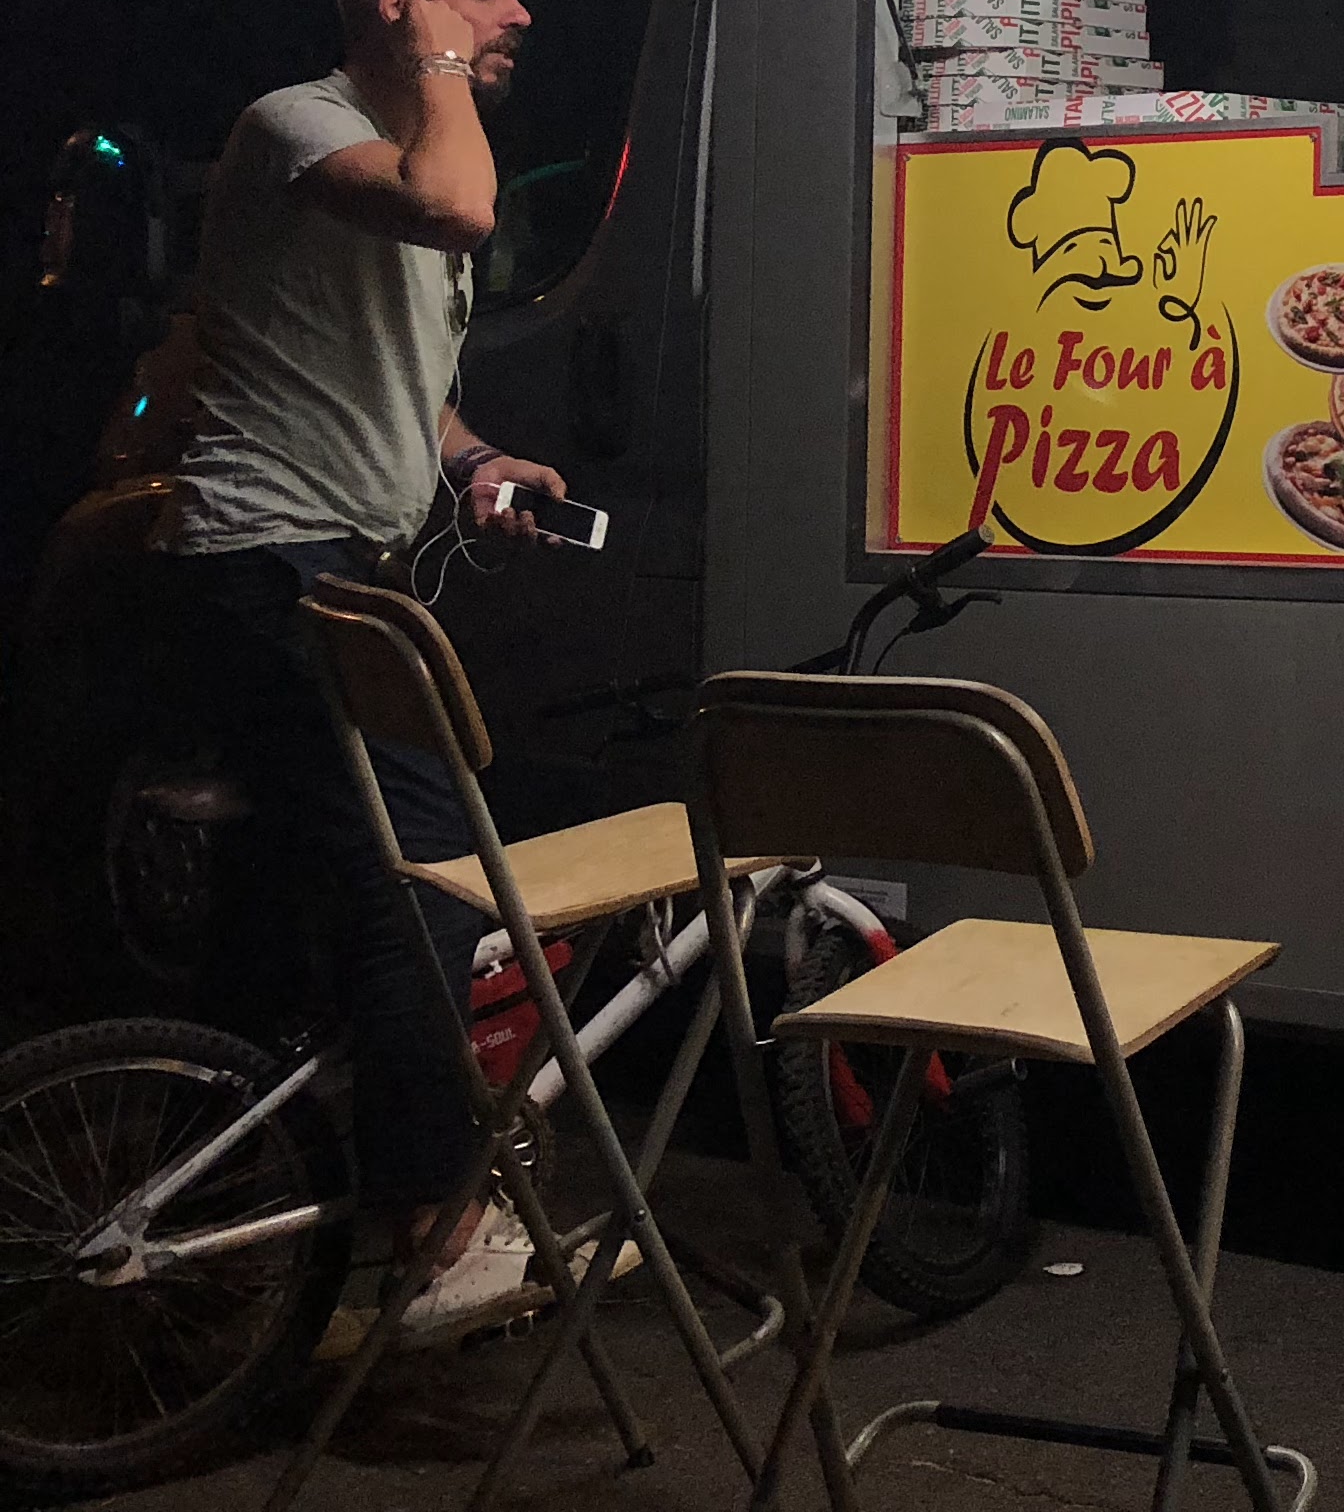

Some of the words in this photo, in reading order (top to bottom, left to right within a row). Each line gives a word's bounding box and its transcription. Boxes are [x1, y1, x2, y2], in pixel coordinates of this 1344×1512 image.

[1004, 106, 1050, 120] SALAMINO
[985, 330, 1036, 392] Le
[1054, 329, 1173, 392] Four
[1189, 327, 1227, 392] à
[967, 403, 1182, 530] Pizza
